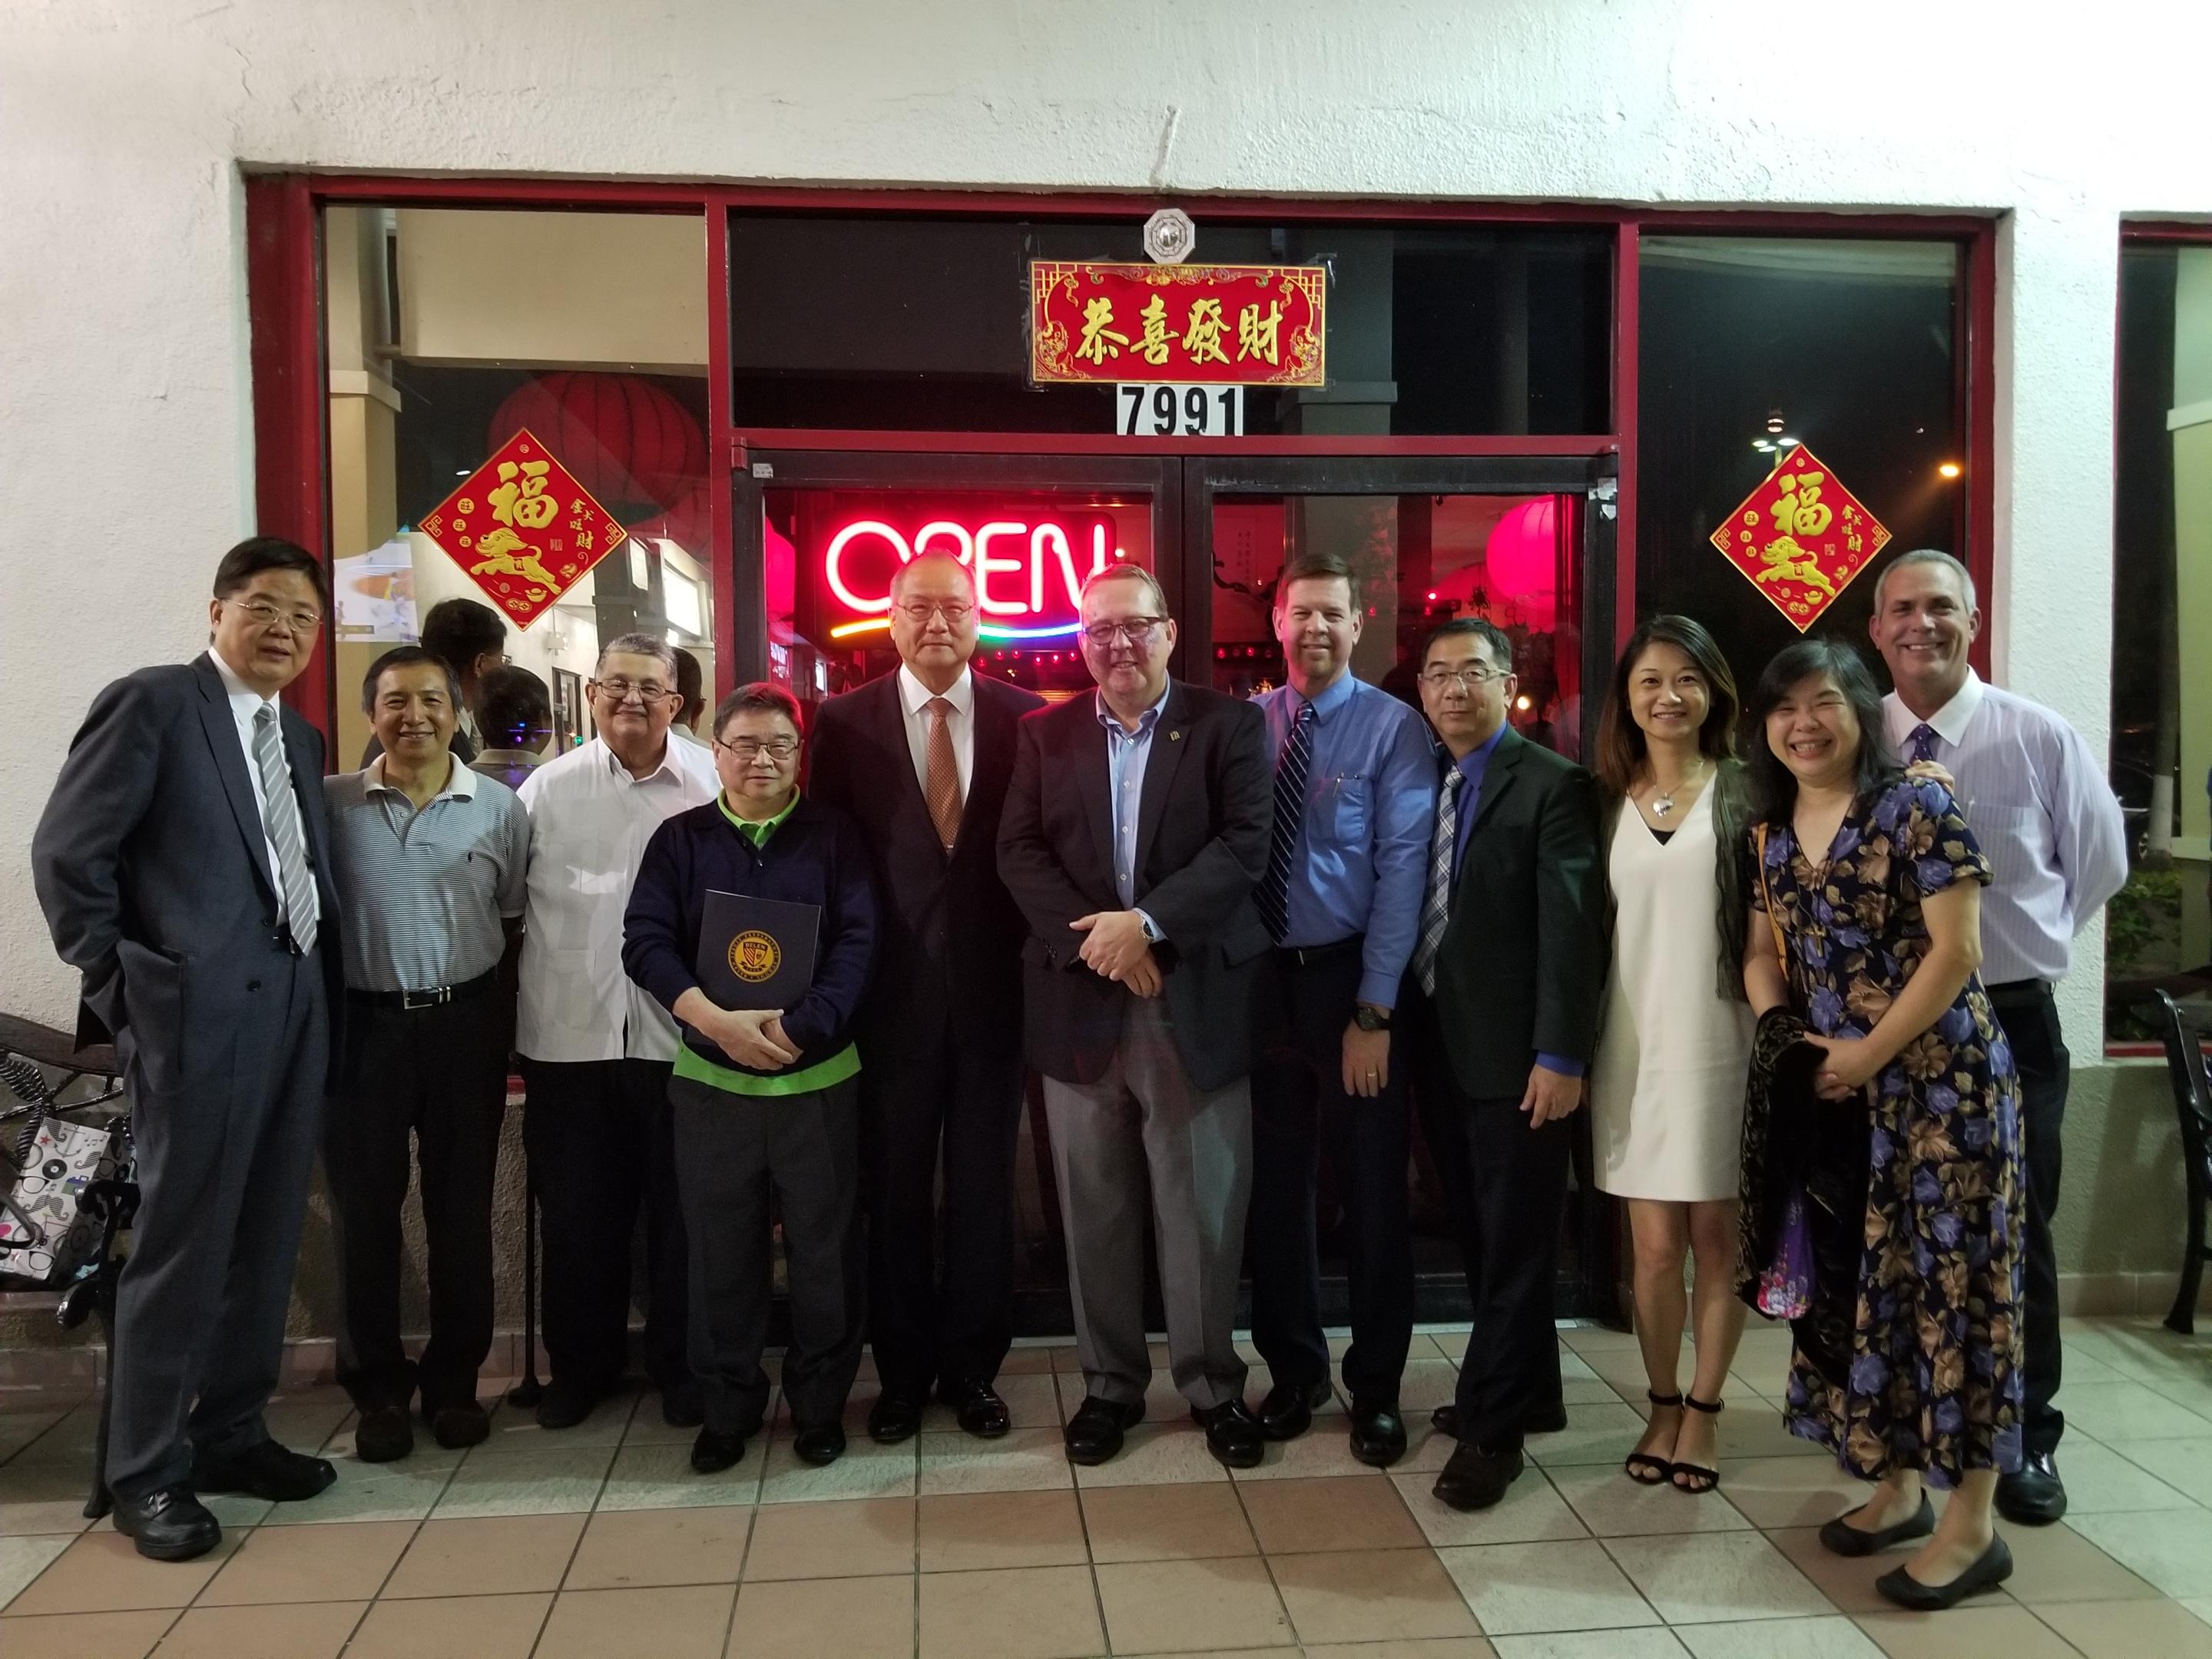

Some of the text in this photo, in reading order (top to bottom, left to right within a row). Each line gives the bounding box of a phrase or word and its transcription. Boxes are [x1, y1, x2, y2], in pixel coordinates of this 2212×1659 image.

[1075, 293, 1283, 366] 恭喜發財
[1121, 386, 1236, 435] 7991
[488, 460, 559, 529] 福
[1770, 471, 1833, 536] 福
